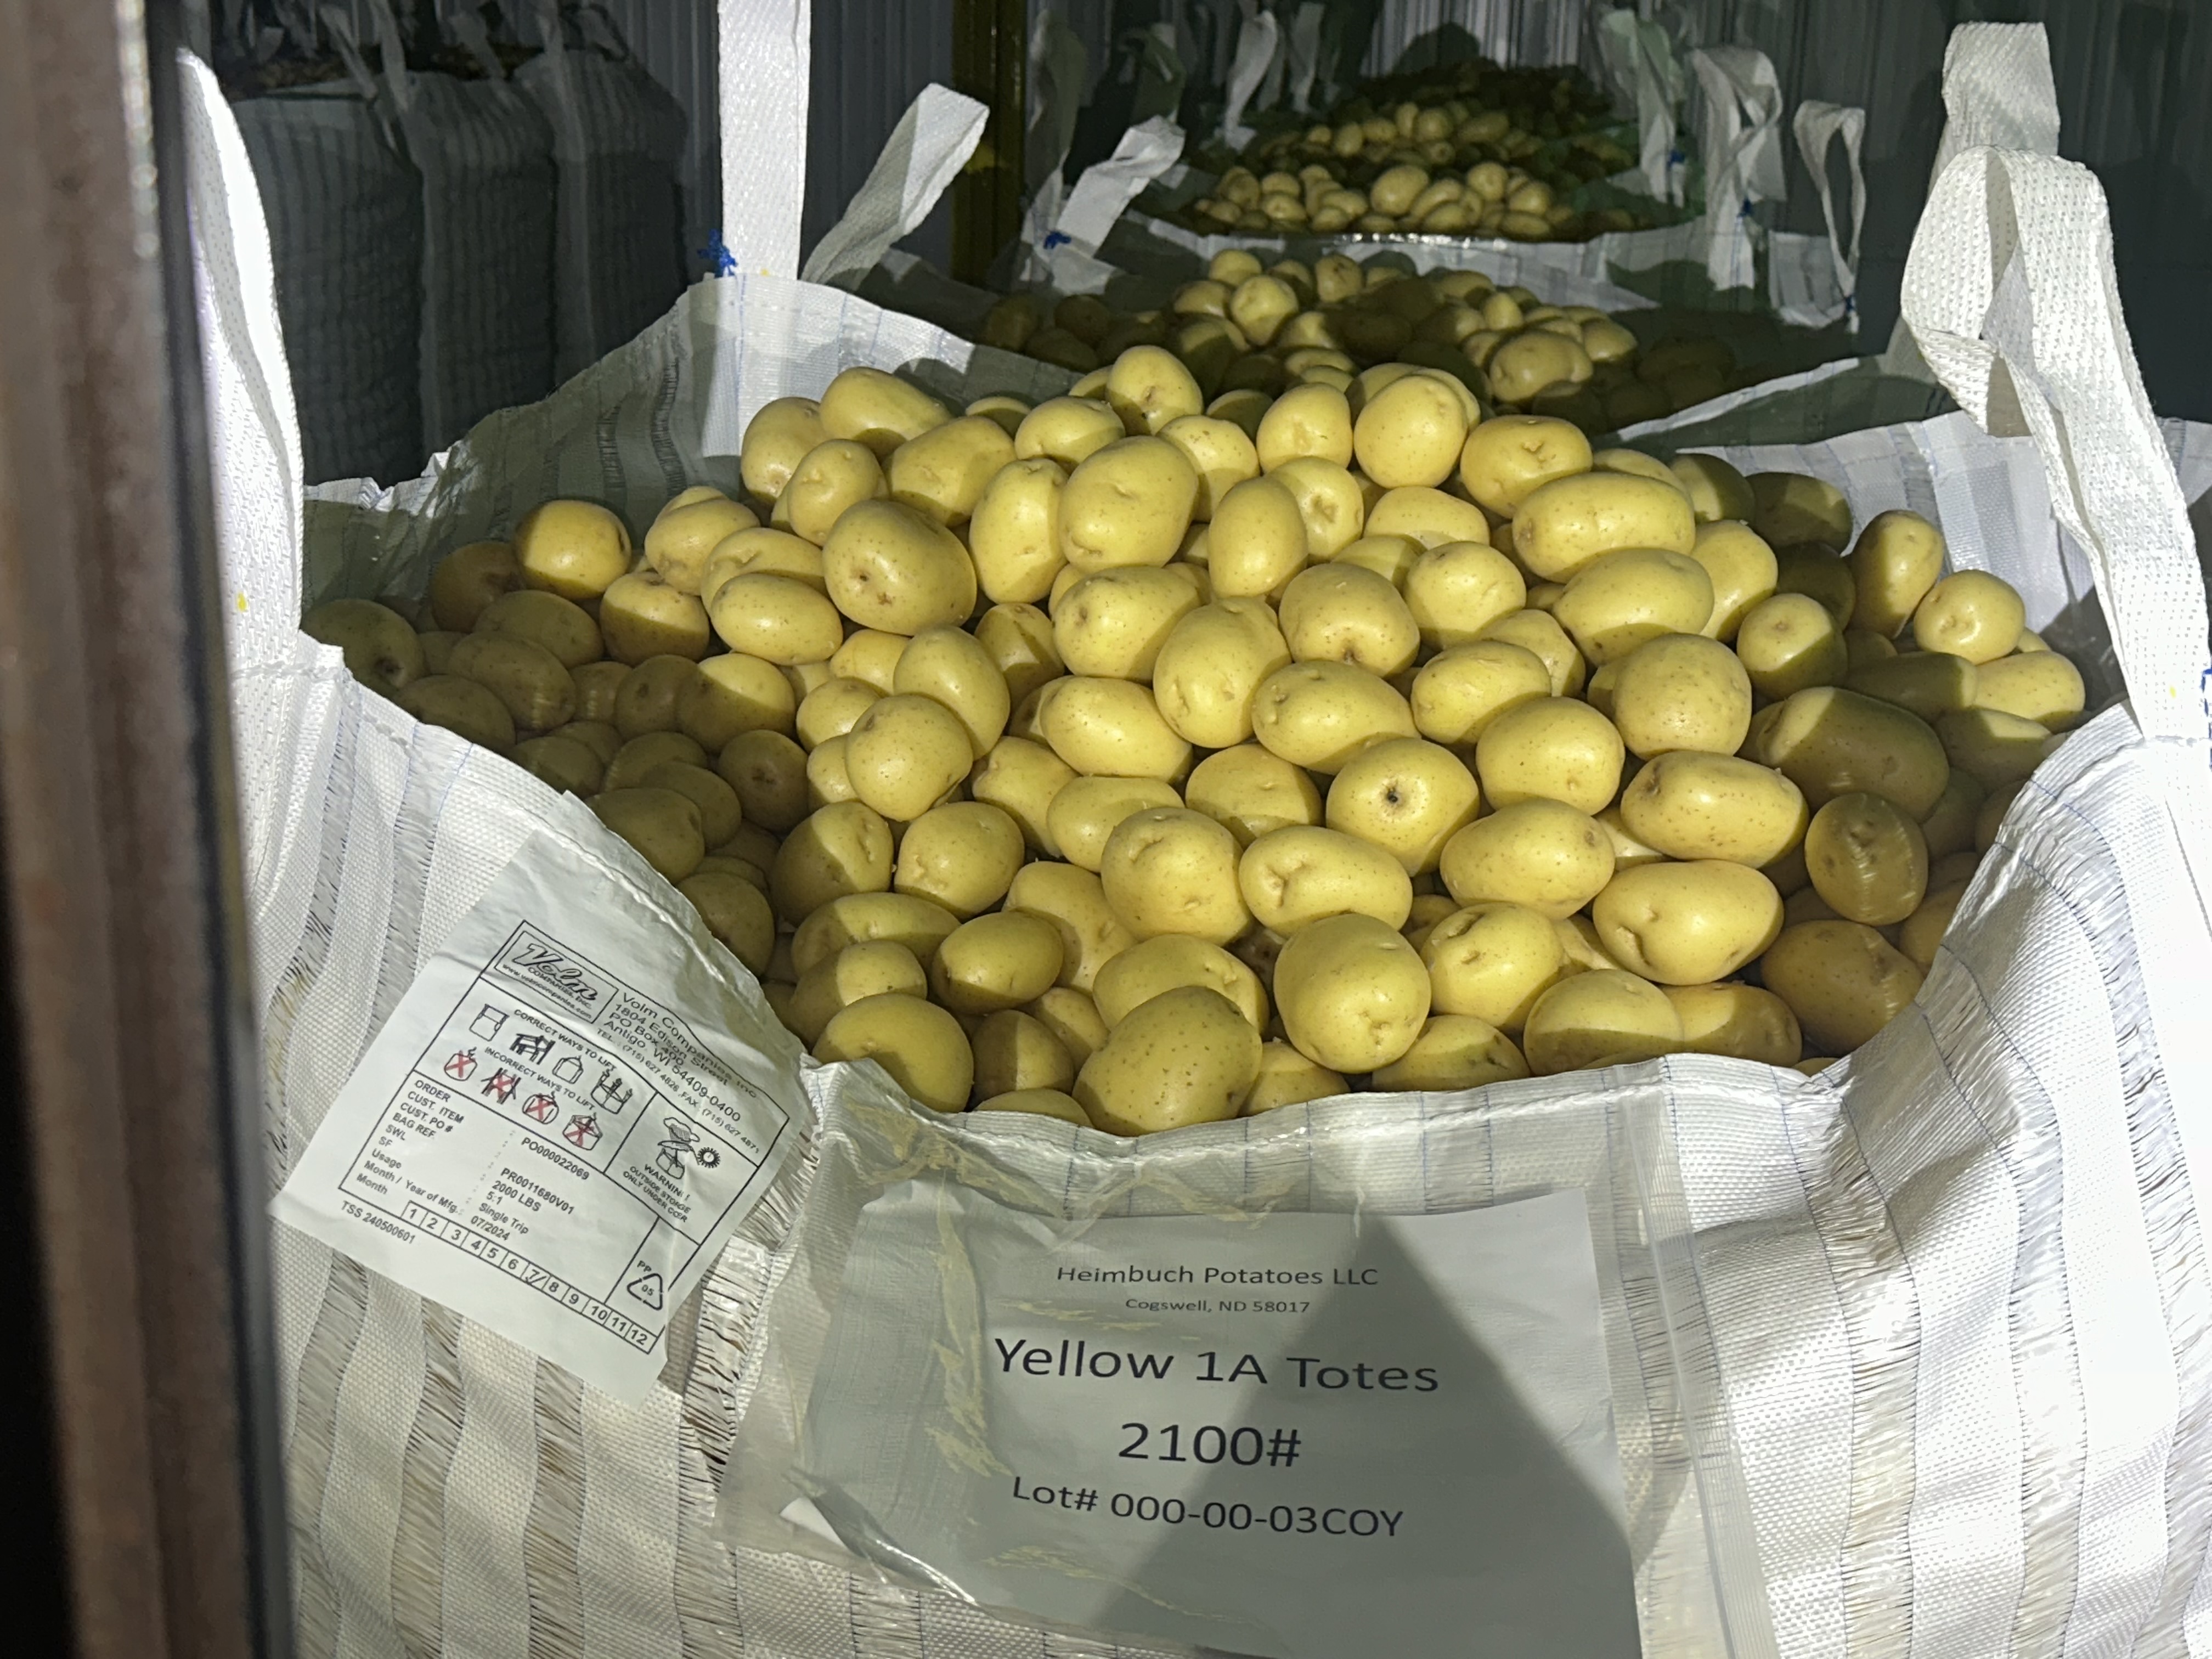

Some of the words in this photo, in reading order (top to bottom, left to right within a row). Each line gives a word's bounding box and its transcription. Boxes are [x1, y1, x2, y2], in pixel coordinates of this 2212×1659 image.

[503, 964, 592, 1019] www.volmcompanies.com
[511, 943, 597, 1000] Volm
[514, 1009, 558, 1037] CORRECT
[558, 1032, 584, 1052] WAYS
[585, 1048, 597, 1059] TO
[598, 1056, 617, 1071] LIFT
[608, 1012, 632, 1028] PO
[634, 1025, 658, 1046] Box
[661, 1047, 684, 1066] 400
[615, 1003, 646, 1024] 1804
[648, 1022, 687, 1058] Edison
[690, 1057, 729, 1086] Street
[623, 992, 658, 1019] Volm
[662, 1017, 732, 1080] Companies
[484, 1046, 537, 1077] INCORRECT
[537, 1074, 563, 1093] WAYS
[563, 1088, 576, 1098] TO
[576, 1096, 596, 1110] LIFT
[622, 1044, 645, 1063] (715)
[645, 1059, 661, 1074] 627
[659, 1074, 680, 1092] 4826
[702, 1108, 724, 1127] (715)
[724, 1123, 741, 1137] 627
[741, 1136, 759, 1153] 4871
[653, 1048, 670, 1066] WI
[672, 1064, 741, 1122] 54409-0400
[400, 1102, 428, 1122] CUST.
[429, 1116, 445, 1129] PO
[407, 1091, 437, 1110] CUST.
[439, 1107, 465, 1124] ITEM
[414, 1080, 451, 1103] ORDER
[521, 1137, 590, 1180] PO000022069
[356, 1172, 388, 1195] Month
[371, 1148, 402, 1169] Usage
[478, 1202, 509, 1224] Single
[511, 1217, 529, 1235] Trip
[378, 1136, 393, 1147] SF
[486, 1190, 503, 1205] 5:1
[385, 1124, 406, 1141] SWL
[492, 1180, 518, 1199] 2000
[518, 1193, 542, 1212] LBS
[392, 1112, 416, 1128] BAG
[500, 1167, 575, 1215] PR0011680V01
[623, 1171, 644, 1187] ONLY
[643, 1186, 668, 1209] UNDER
[630, 1166, 661, 1193] OUTSIDE
[644, 1164, 684, 1198] WARNIN
[341, 1200, 363, 1218] TSS
[362, 1212, 416, 1244] 240500601
[364, 1160, 396, 1182] Month
[405, 1180, 426, 1197] Year
[426, 1193, 440, 1201] of
[470, 1215, 511, 1241] 07/2024
[410, 1208, 417, 1219] 1
[426, 1217, 438, 1229] 2
[451, 1229, 462, 1240] 3
[471, 1239, 482, 1251] 4
[486, 1248, 499, 1259] 5
[507, 1258, 519, 1270] 6
[529, 1269, 540, 1279] 7
[549, 1282, 559, 1293] 8
[569, 1294, 579, 1305] 9
[591, 1305, 608, 1321] 10
[611, 1316, 628, 1332] 11
[630, 1328, 648, 1346] 12
[637, 1260, 652, 1272] PP
[641, 1284, 654, 1296] 05
[1057, 1266, 1194, 1284] Heimbuch
[1204, 1266, 1324, 1285] Potatoes
[1333, 1268, 1379, 1286] LLC
[1125, 1298, 1212, 1313] Cogswell,
[1219, 1300, 1248, 1312] ND
[1252, 1300, 1311, 1314] 58017
[994, 1338, 1175, 1379] Yellow
[1195, 1351, 1268, 1384] 1A
[1286, 1357, 1440, 1392] Totes
[1118, 1422, 1302, 1468] 2100#
[1012, 1476, 1099, 1512] Lot#
[1110, 1492, 1404, 1537] 000-00-03COY
